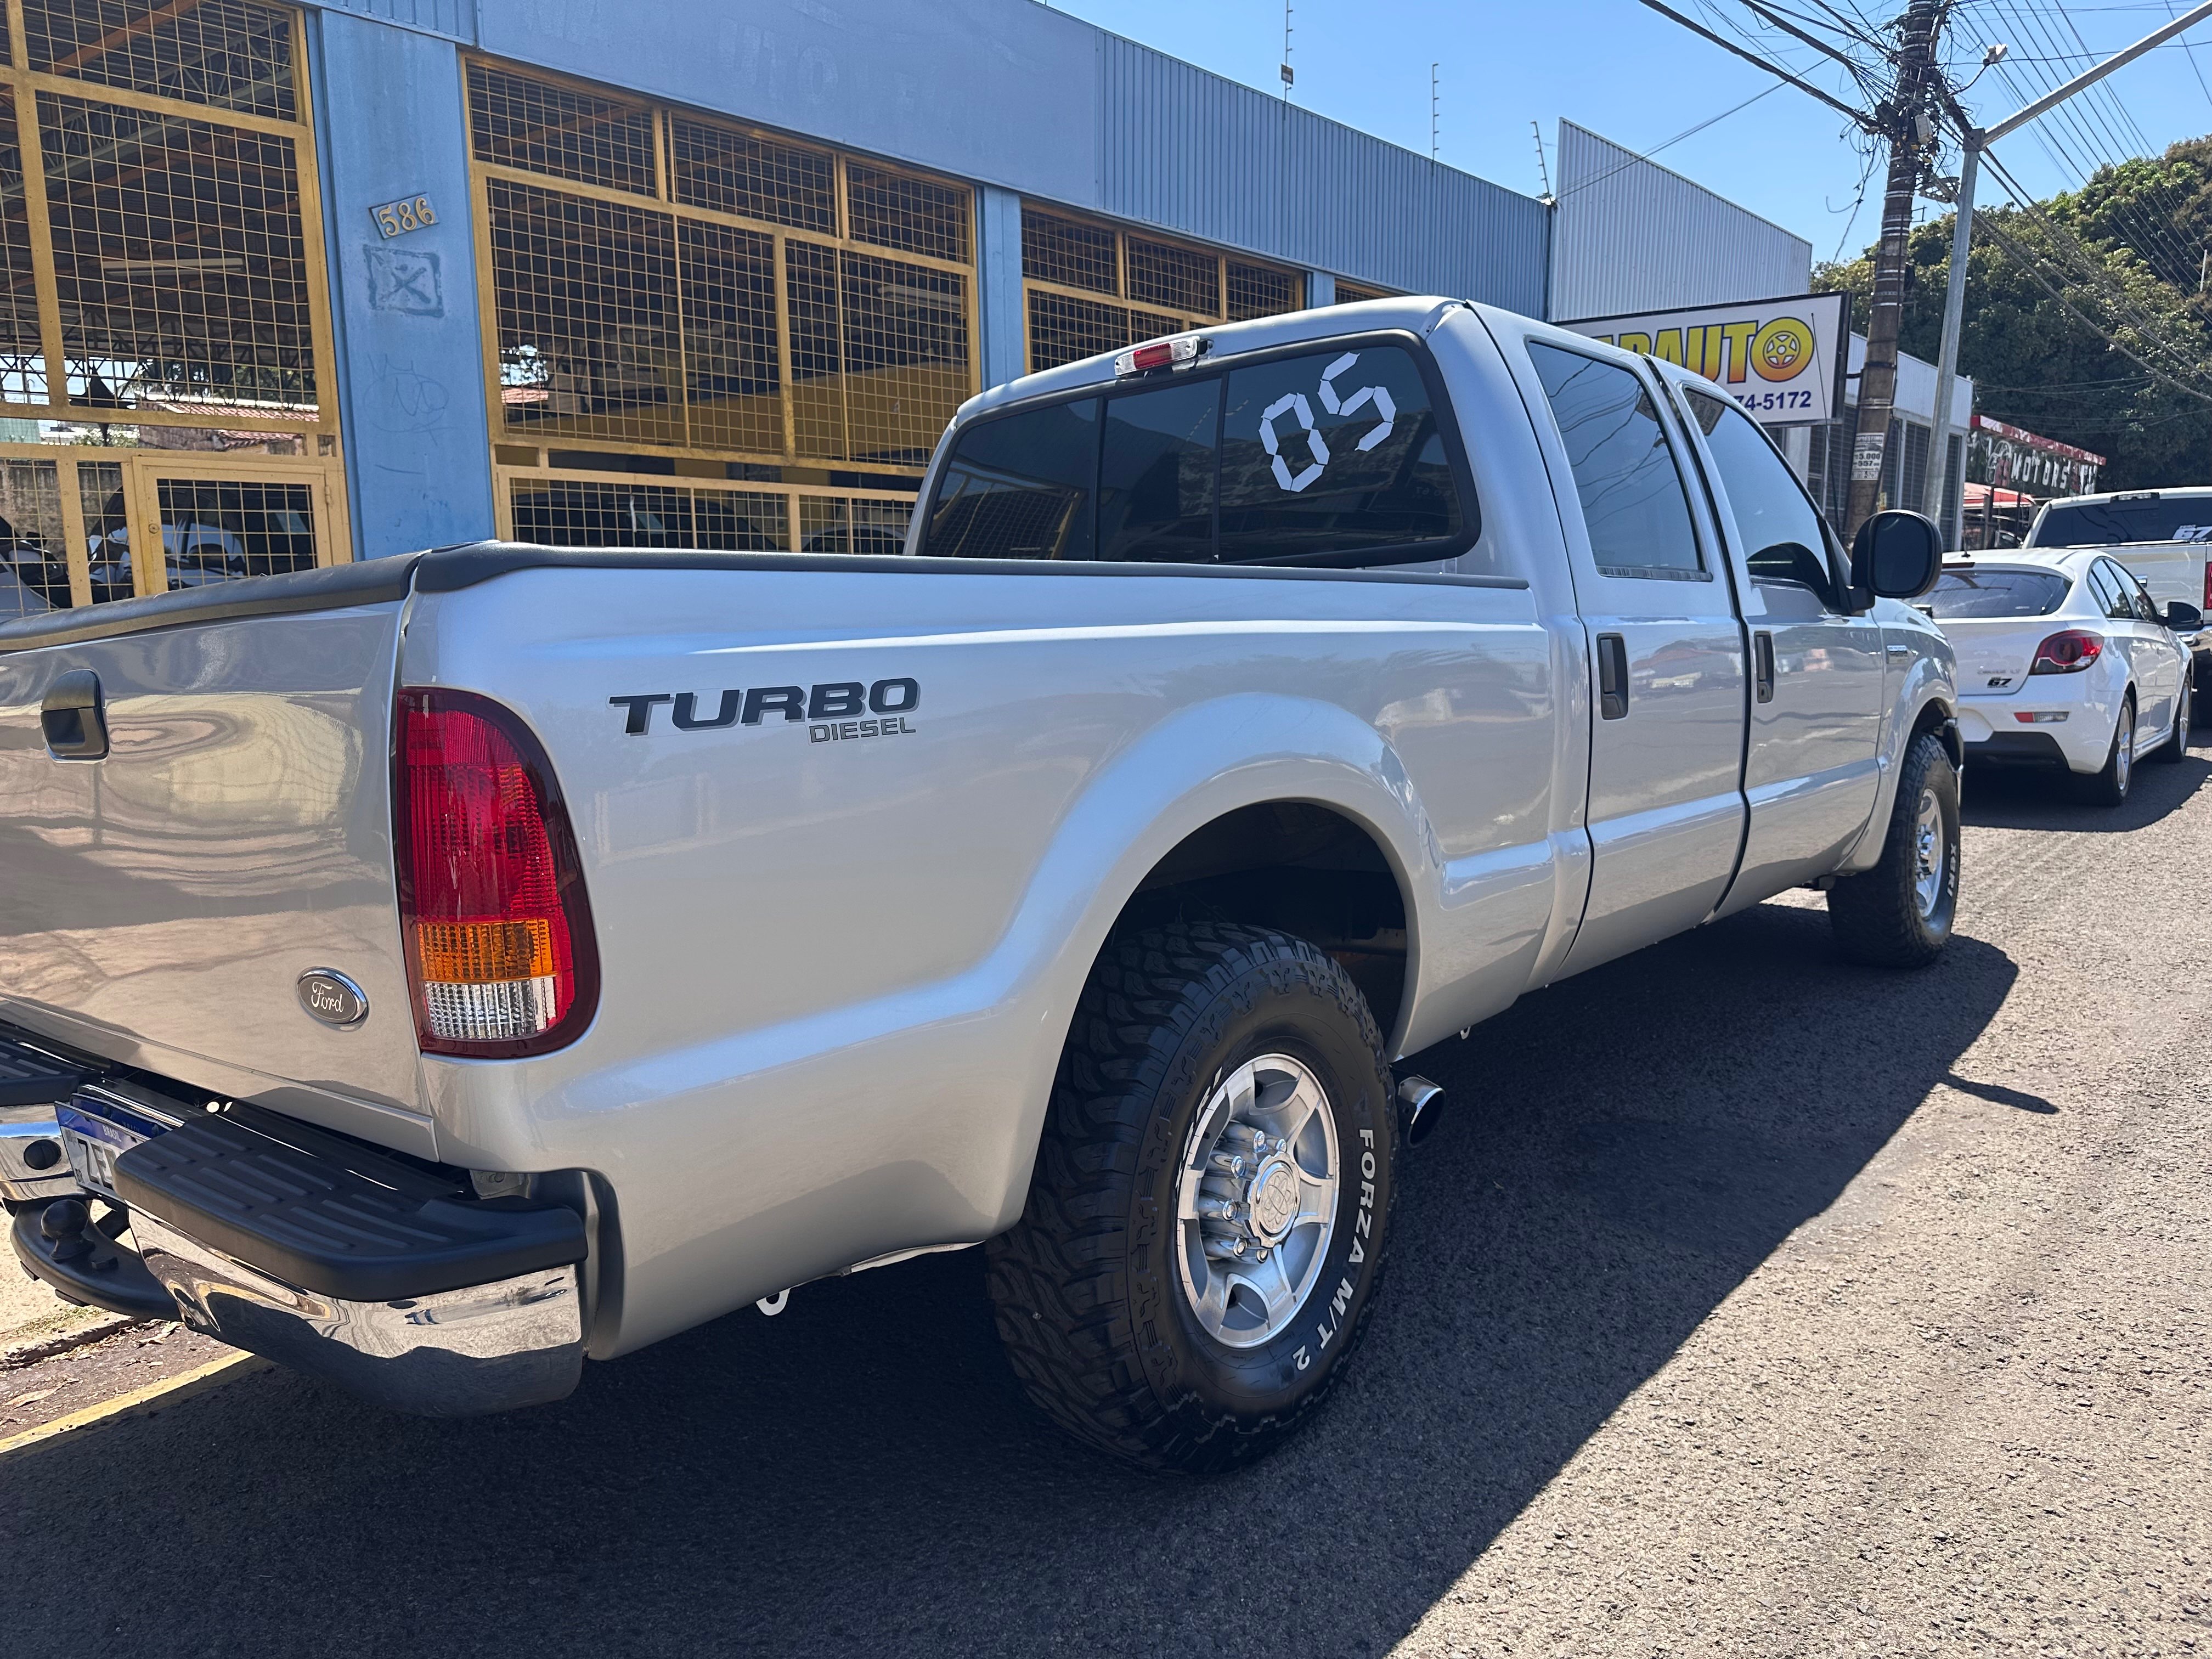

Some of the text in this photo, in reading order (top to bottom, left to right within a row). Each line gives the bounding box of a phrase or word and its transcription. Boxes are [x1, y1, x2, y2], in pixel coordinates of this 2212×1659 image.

[378, 198, 436, 236] 586
[1592, 317, 1814, 385] AUTO
[1259, 352, 1397, 493] 05
[609, 678, 921, 736] TURBO
[809, 717, 916, 743] DIESEL
[311, 981, 345, 1013] Ford
[102, 1124, 122, 1142] BRASIL
[1292, 1128, 1376, 1370] FORZA M/T 2
